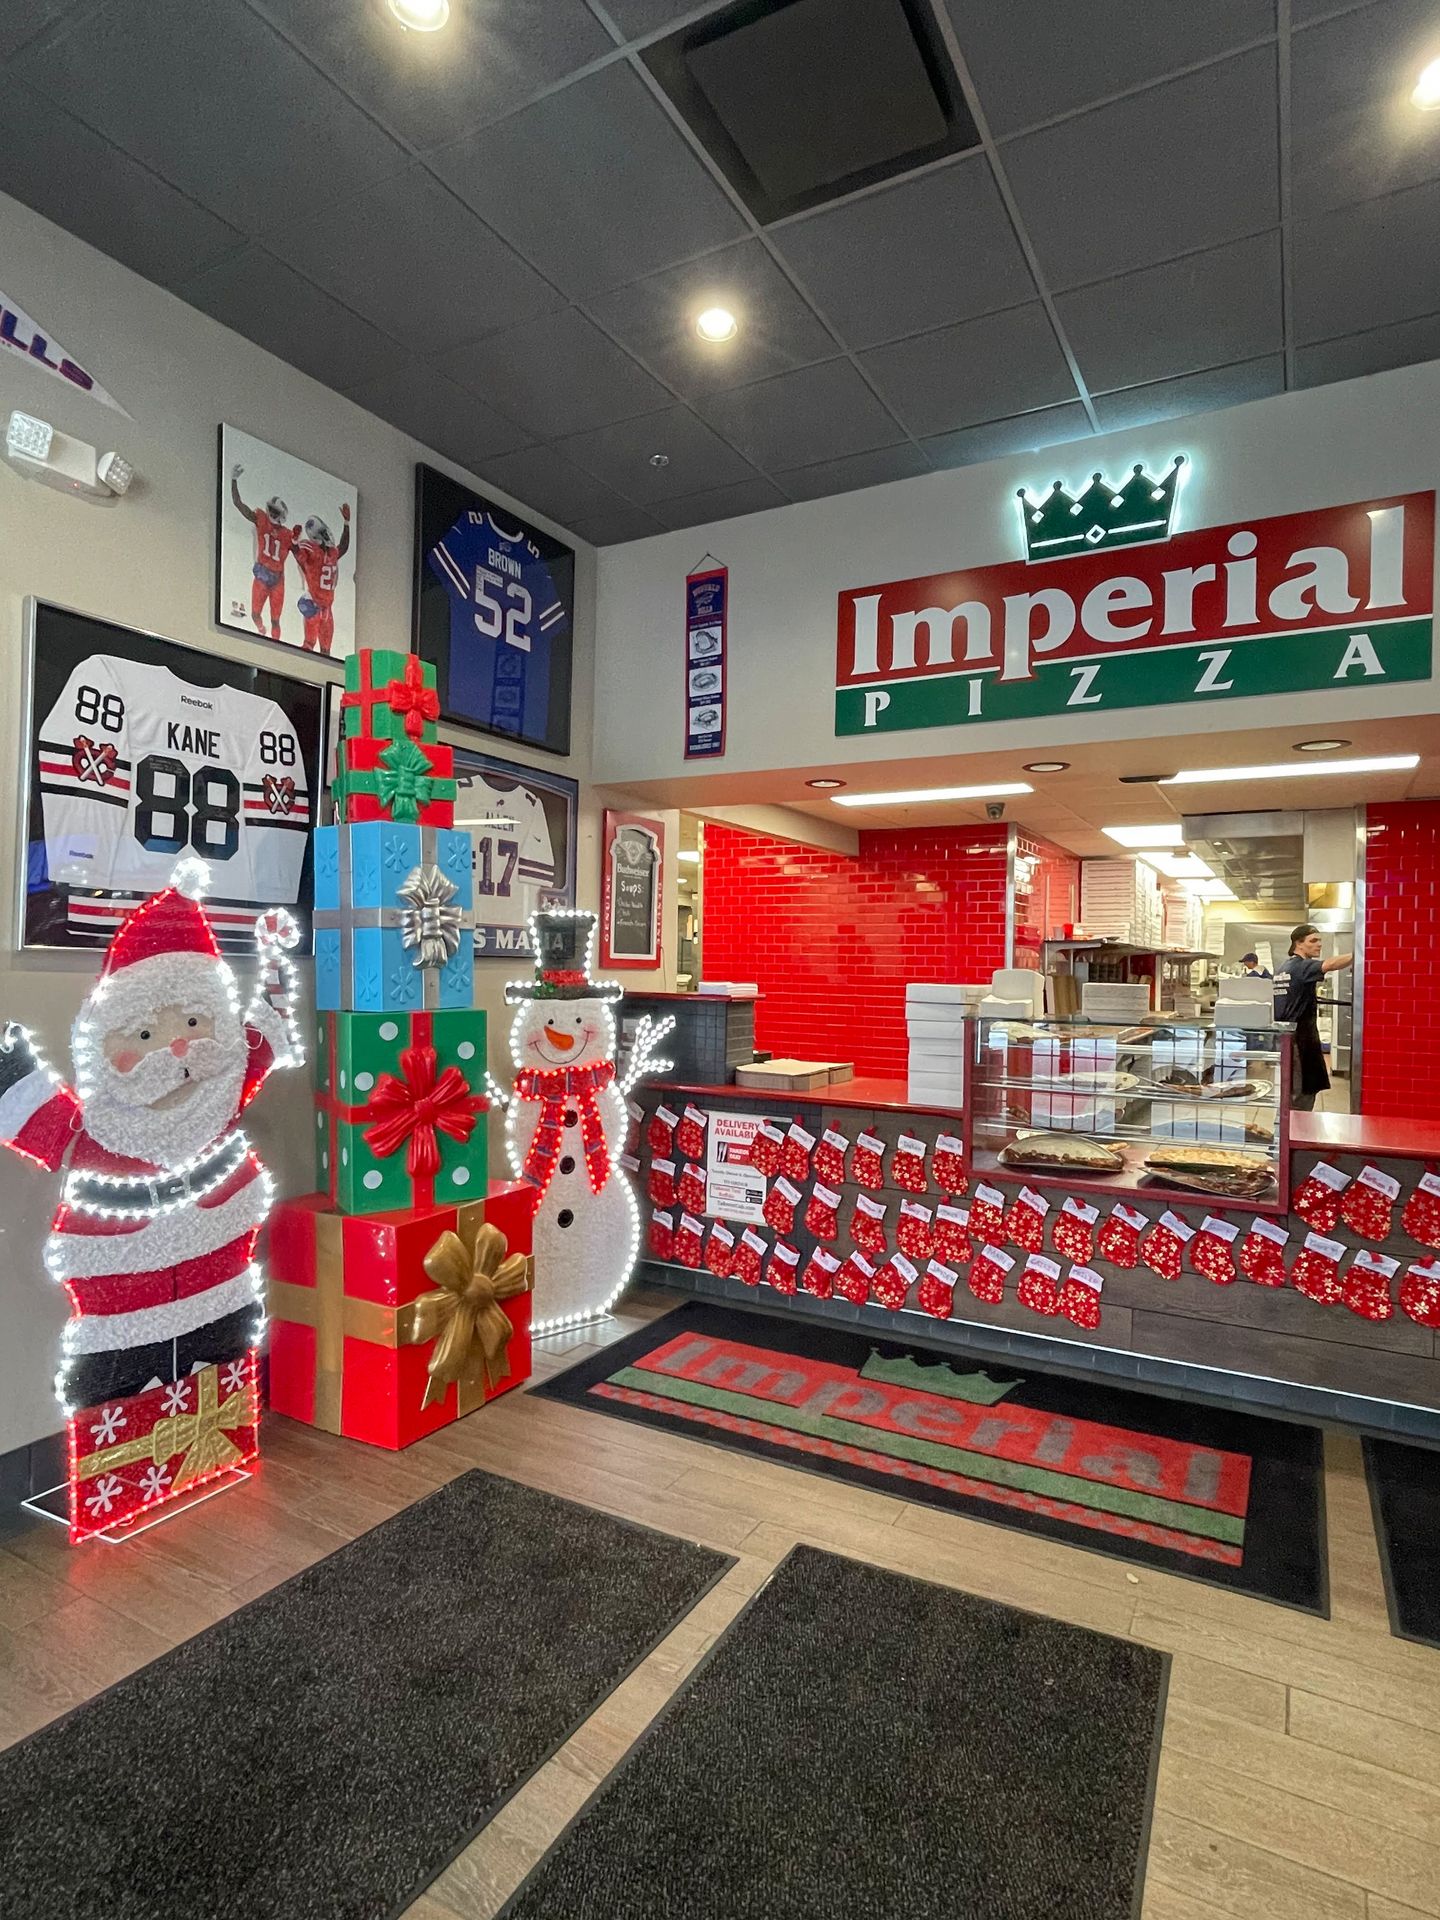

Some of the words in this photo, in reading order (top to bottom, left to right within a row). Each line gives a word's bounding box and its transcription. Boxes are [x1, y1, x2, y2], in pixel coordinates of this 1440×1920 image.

[0, 303, 94, 391] LLS
[263, 533, 280, 562] 11
[488, 547, 521, 579] BROWN
[474, 565, 532, 652] 52
[851, 505, 1407, 681] Imperial
[863, 633, 1386, 727] PIZZA
[75, 685, 125, 733] 88
[180, 694, 213, 710] Reebok
[167, 721, 221, 759] KANE
[259, 731, 296, 766] 88
[134, 754, 240, 861] 88
[478, 837, 519, 897] 17
[617, 862, 650, 877] Budweiser
[714, 1127, 754, 1139] AVAILABL
[716, 1118, 760, 1130] DELIVERY
[656, 1339, 1221, 1502] Imperial
